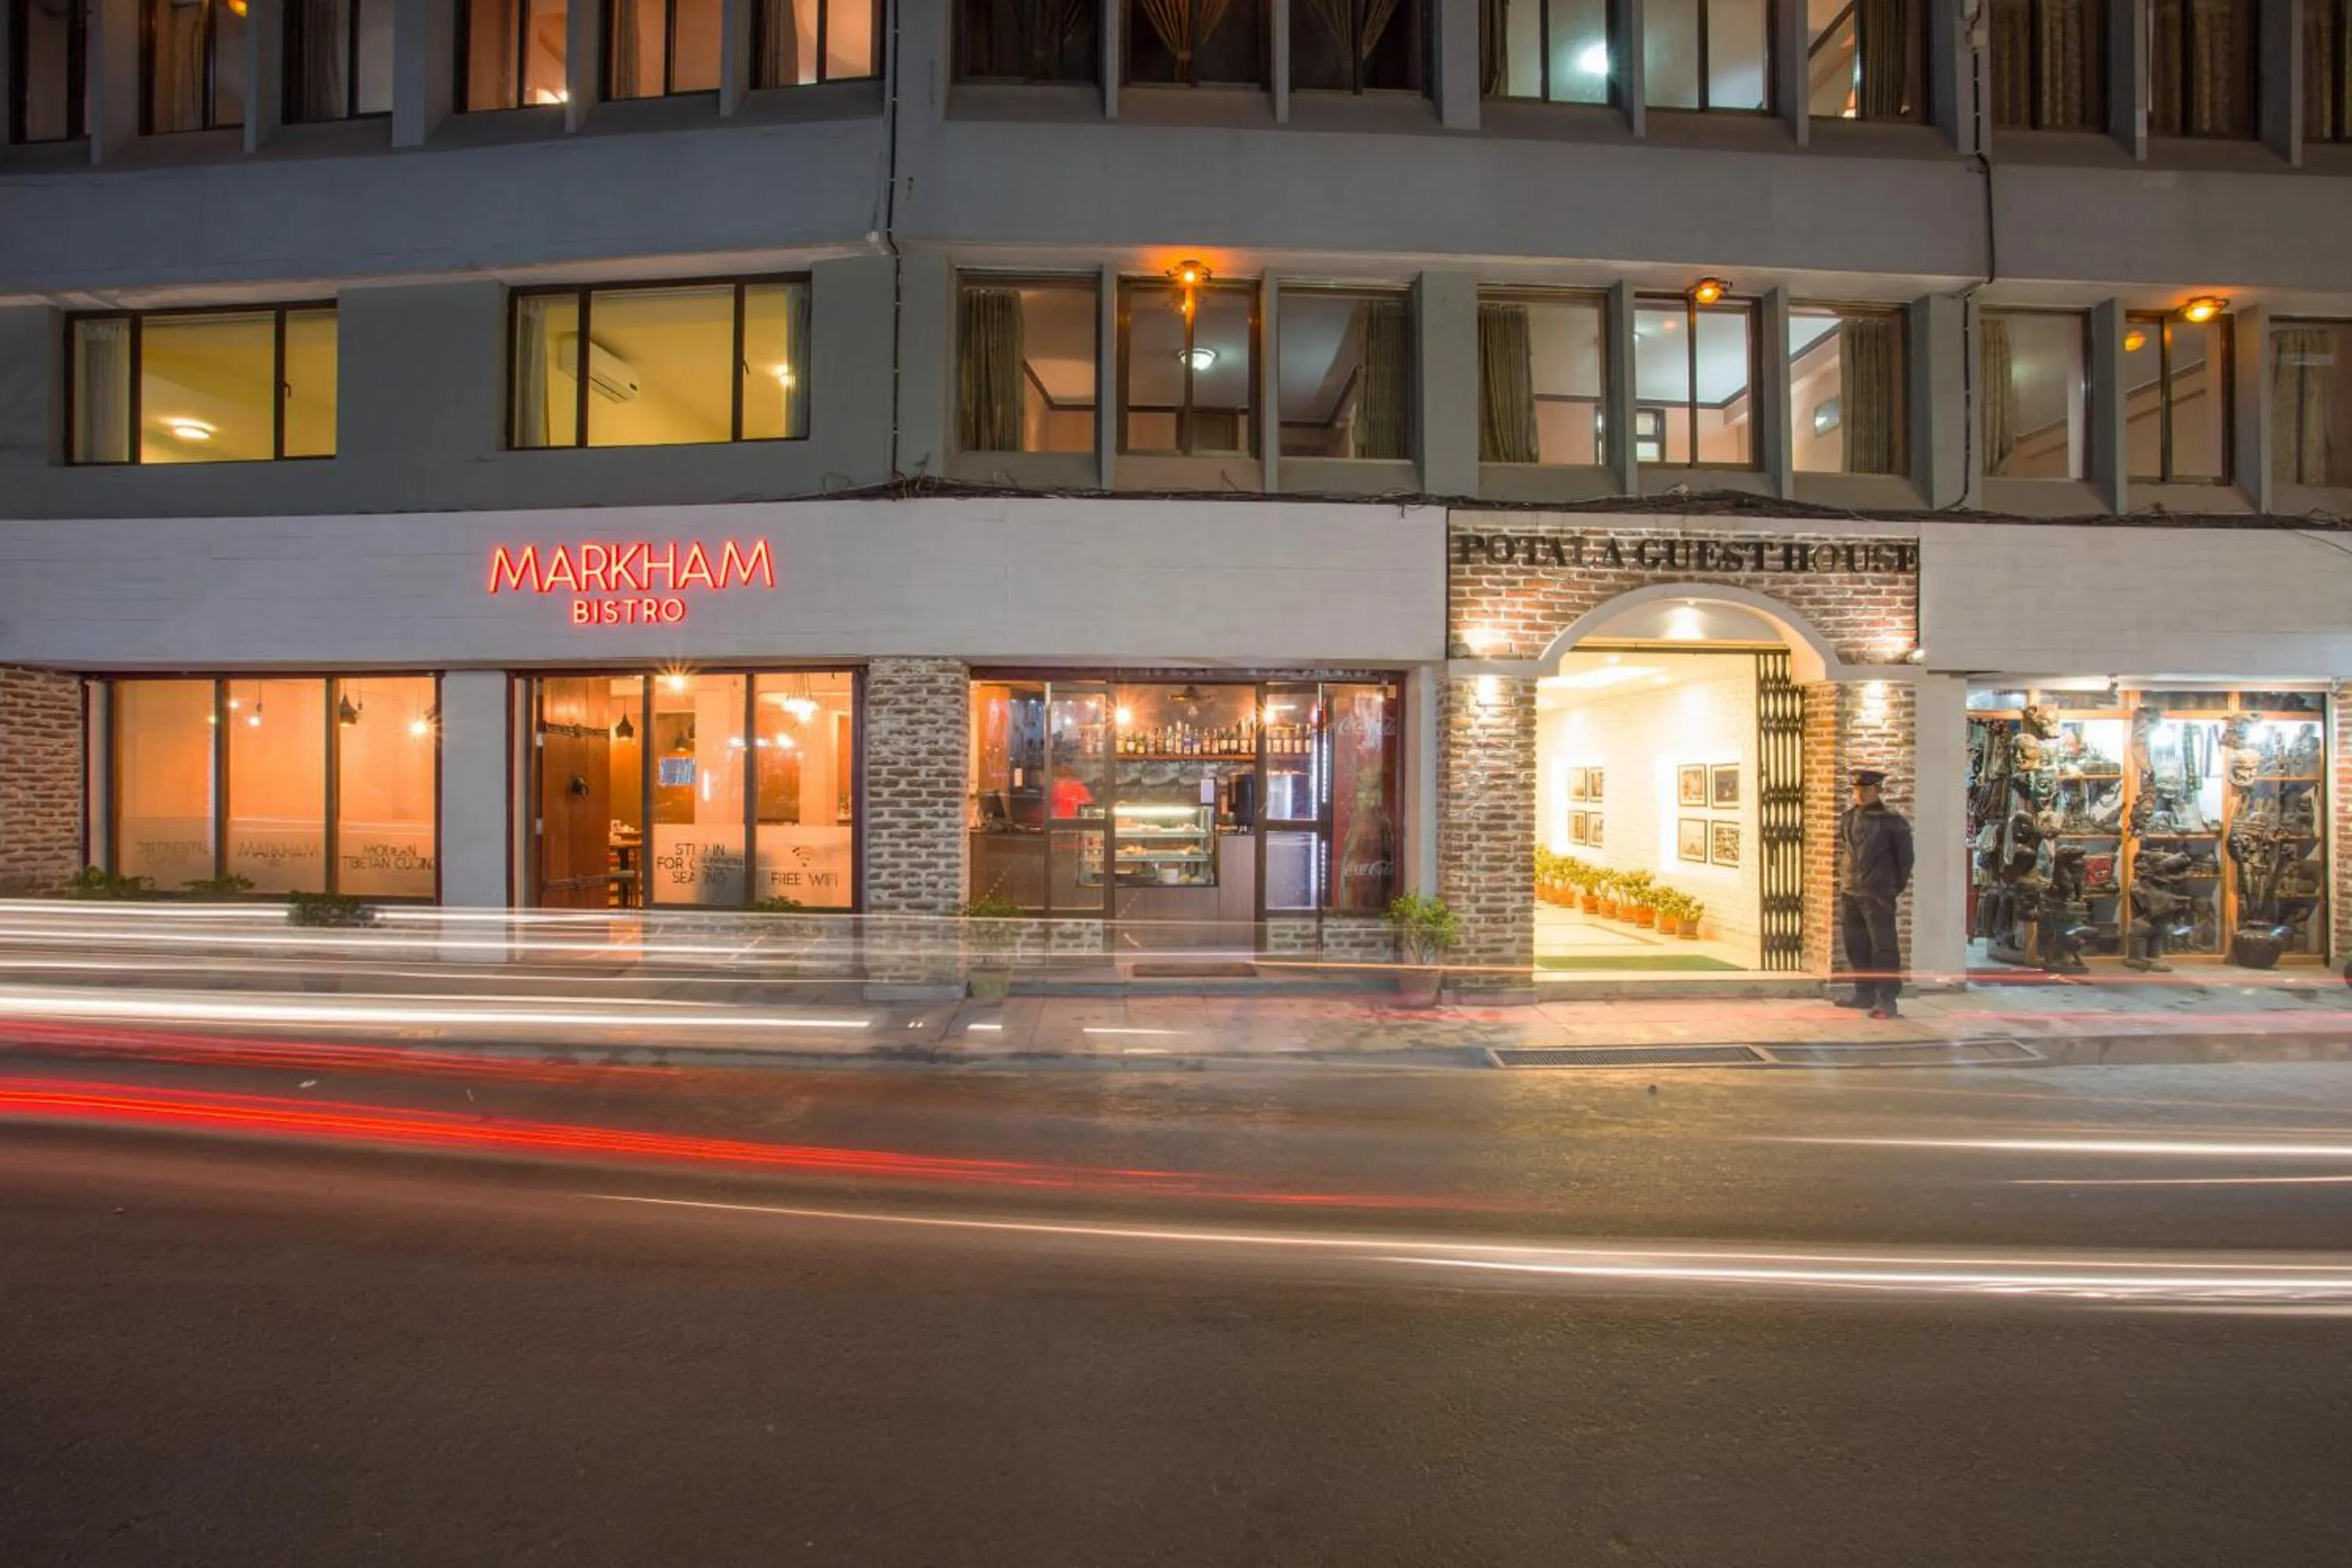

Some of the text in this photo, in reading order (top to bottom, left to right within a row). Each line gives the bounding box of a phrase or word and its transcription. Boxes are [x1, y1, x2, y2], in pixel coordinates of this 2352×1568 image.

[1456, 534, 1628, 568] POTALA
[489, 539, 775, 593] MARKHAM
[574, 598, 686, 624] BISTRO
[713, 844, 725, 856] IN
[339, 855, 390, 869] TBETAN
[657, 856, 684, 869] FOR
[672, 871, 726, 884] SEANG
[771, 872, 802, 885] FREE
